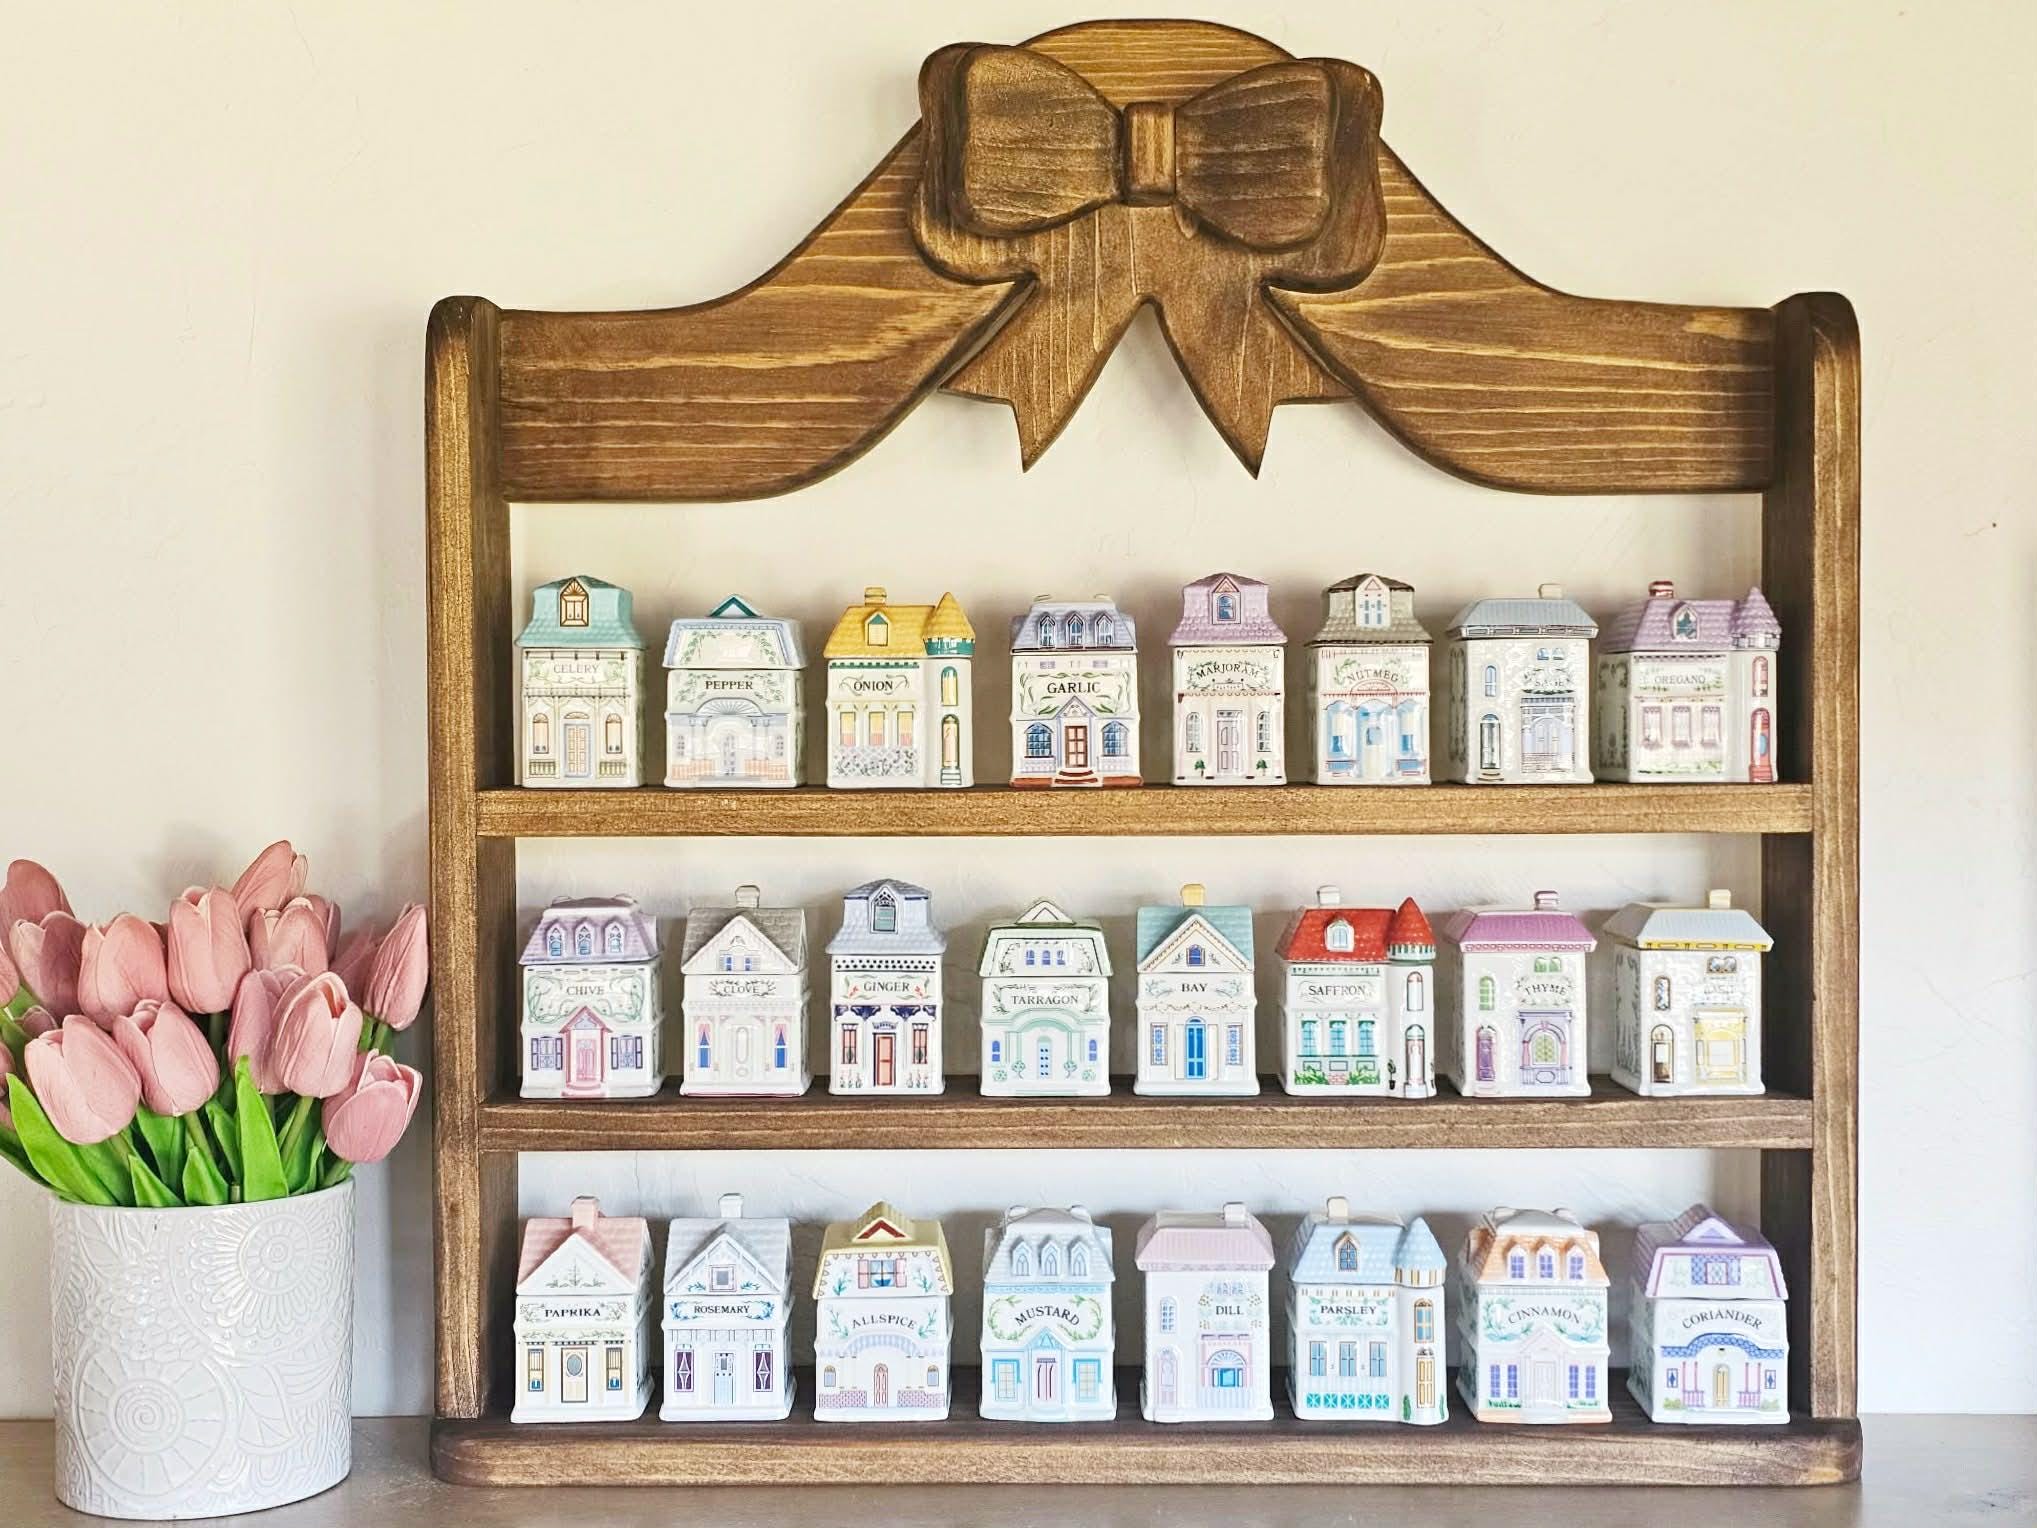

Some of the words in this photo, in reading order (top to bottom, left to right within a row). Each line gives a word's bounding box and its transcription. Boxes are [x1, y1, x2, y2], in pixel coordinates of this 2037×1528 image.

[552, 663, 600, 674] CELERY
[1196, 663, 1260, 679] MARJORAM
[1346, 669, 1399, 682] NUTMEG
[1654, 674, 1706, 685] OREGANO
[705, 680, 754, 690] PEPPER
[853, 680, 894, 691] ONION
[1046, 681, 1101, 693] GARLIC
[566, 986, 605, 996] CHIVE
[723, 985, 760, 994] CLOVE
[863, 981, 910, 993] GINGER
[1181, 983, 1209, 993] BAY
[1308, 985, 1367, 996] SAFFRON
[1525, 983, 1567, 996] THYME
[1010, 994, 1079, 1006] TARRAGON
[544, 1308, 601, 1318] PAPRIKA
[693, 1304, 750, 1314] ROSEMARY
[1215, 1305, 1245, 1316] DILL
[1320, 1304, 1378, 1315] PARSLEY
[1015, 1305, 1081, 1326] MUSTARD
[1507, 1306, 1581, 1325] CINNAMON
[1681, 1309, 1763, 1331] CORIANDER
[851, 1314, 918, 1331] ALLSPICE
